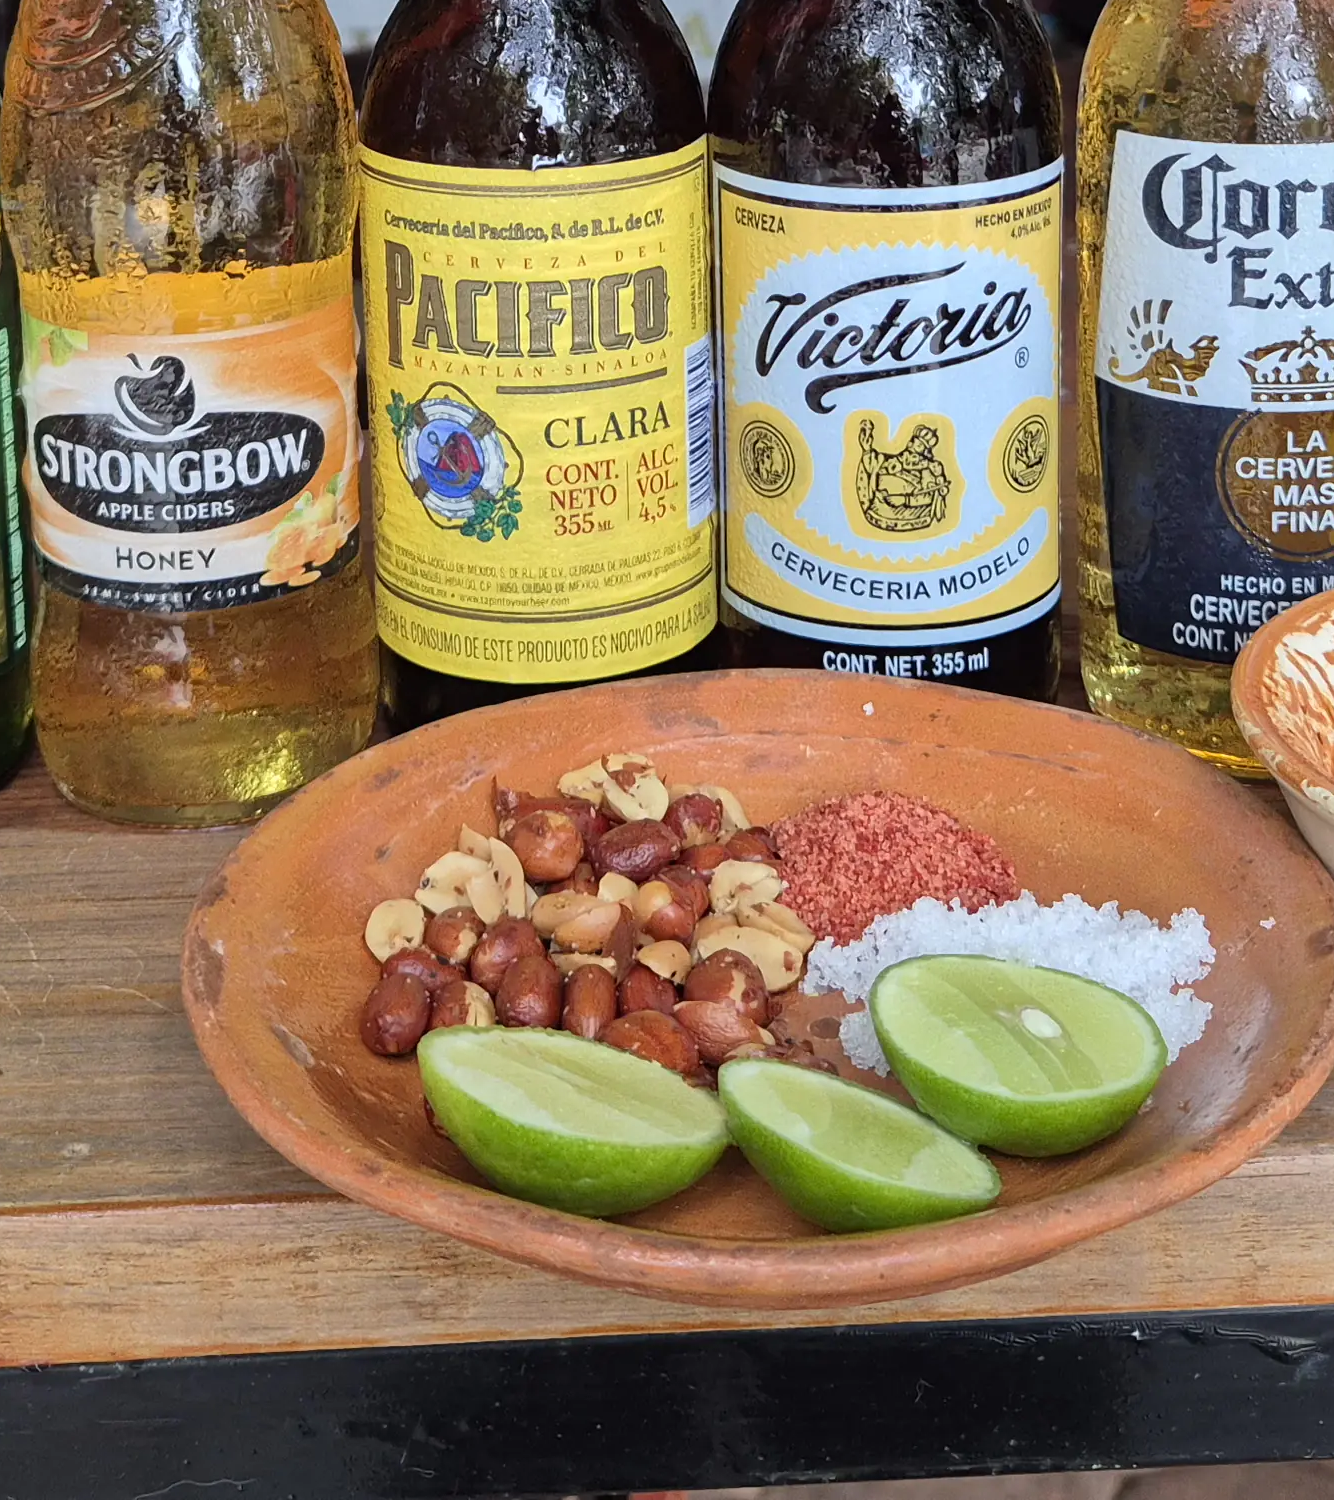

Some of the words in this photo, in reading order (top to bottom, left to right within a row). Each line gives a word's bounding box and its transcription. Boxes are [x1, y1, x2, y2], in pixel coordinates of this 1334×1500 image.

[452, 221, 477, 239] del
[552, 222, 566, 240] S.
[568, 220, 589, 238] de
[591, 218, 624, 237] R.L.
[625, 213, 643, 231] de
[644, 208, 665, 228] C.V.
[735, 206, 786, 235] CERVEZA
[975, 211, 1011, 228] HECHO
[1013, 207, 1025, 221] EN
[423, 250, 588, 270] CERVEZA
[614, 241, 667, 263] DEL
[384, 239, 670, 371] PACIFICO
[755, 260, 1032, 414] Victoria
[565, 348, 668, 376] SINALOA
[543, 400, 671, 449] CLARA
[1285, 429, 1327, 454] LA
[39, 428, 310, 494] STRONGBOW
[545, 458, 619, 486] CONT.
[636, 444, 679, 474] ALC.
[549, 484, 618, 512] NETO
[636, 469, 680, 499] VOL.
[95, 500, 155, 521] APPLE
[161, 499, 236, 521] CIDERS
[554, 512, 596, 536] 355
[116, 547, 216, 571] HONEY
[509, 568, 519, 579] DE
[538, 567, 548, 579] DE
[607, 559, 616, 572] DE
[770, 541, 931, 601] CERVECERIA
[938, 535, 1032, 598] MODELO
[82, 582, 193, 604] SEMI-SWEET
[204, 582, 261, 601] CIDER
[1220, 574, 1287, 595] HECHO
[1291, 575, 1315, 594] EN
[400, 615, 410, 641] EL
[410, 621, 462, 656] CONSUMO
[464, 635, 480, 659] DE
[483, 638, 514, 663] ESTE
[517, 637, 588, 663] PRODUCTO
[592, 634, 607, 658] ES
[610, 623, 654, 655] NOCIVO
[655, 614, 681, 642] PARA
[681, 608, 693, 632] LA
[1173, 622, 1229, 652] CONT.
[822, 650, 880, 675] CONT.
[885, 654, 929, 678] NET.
[931, 653, 965, 677] 355
[966, 647, 990, 672] ml
